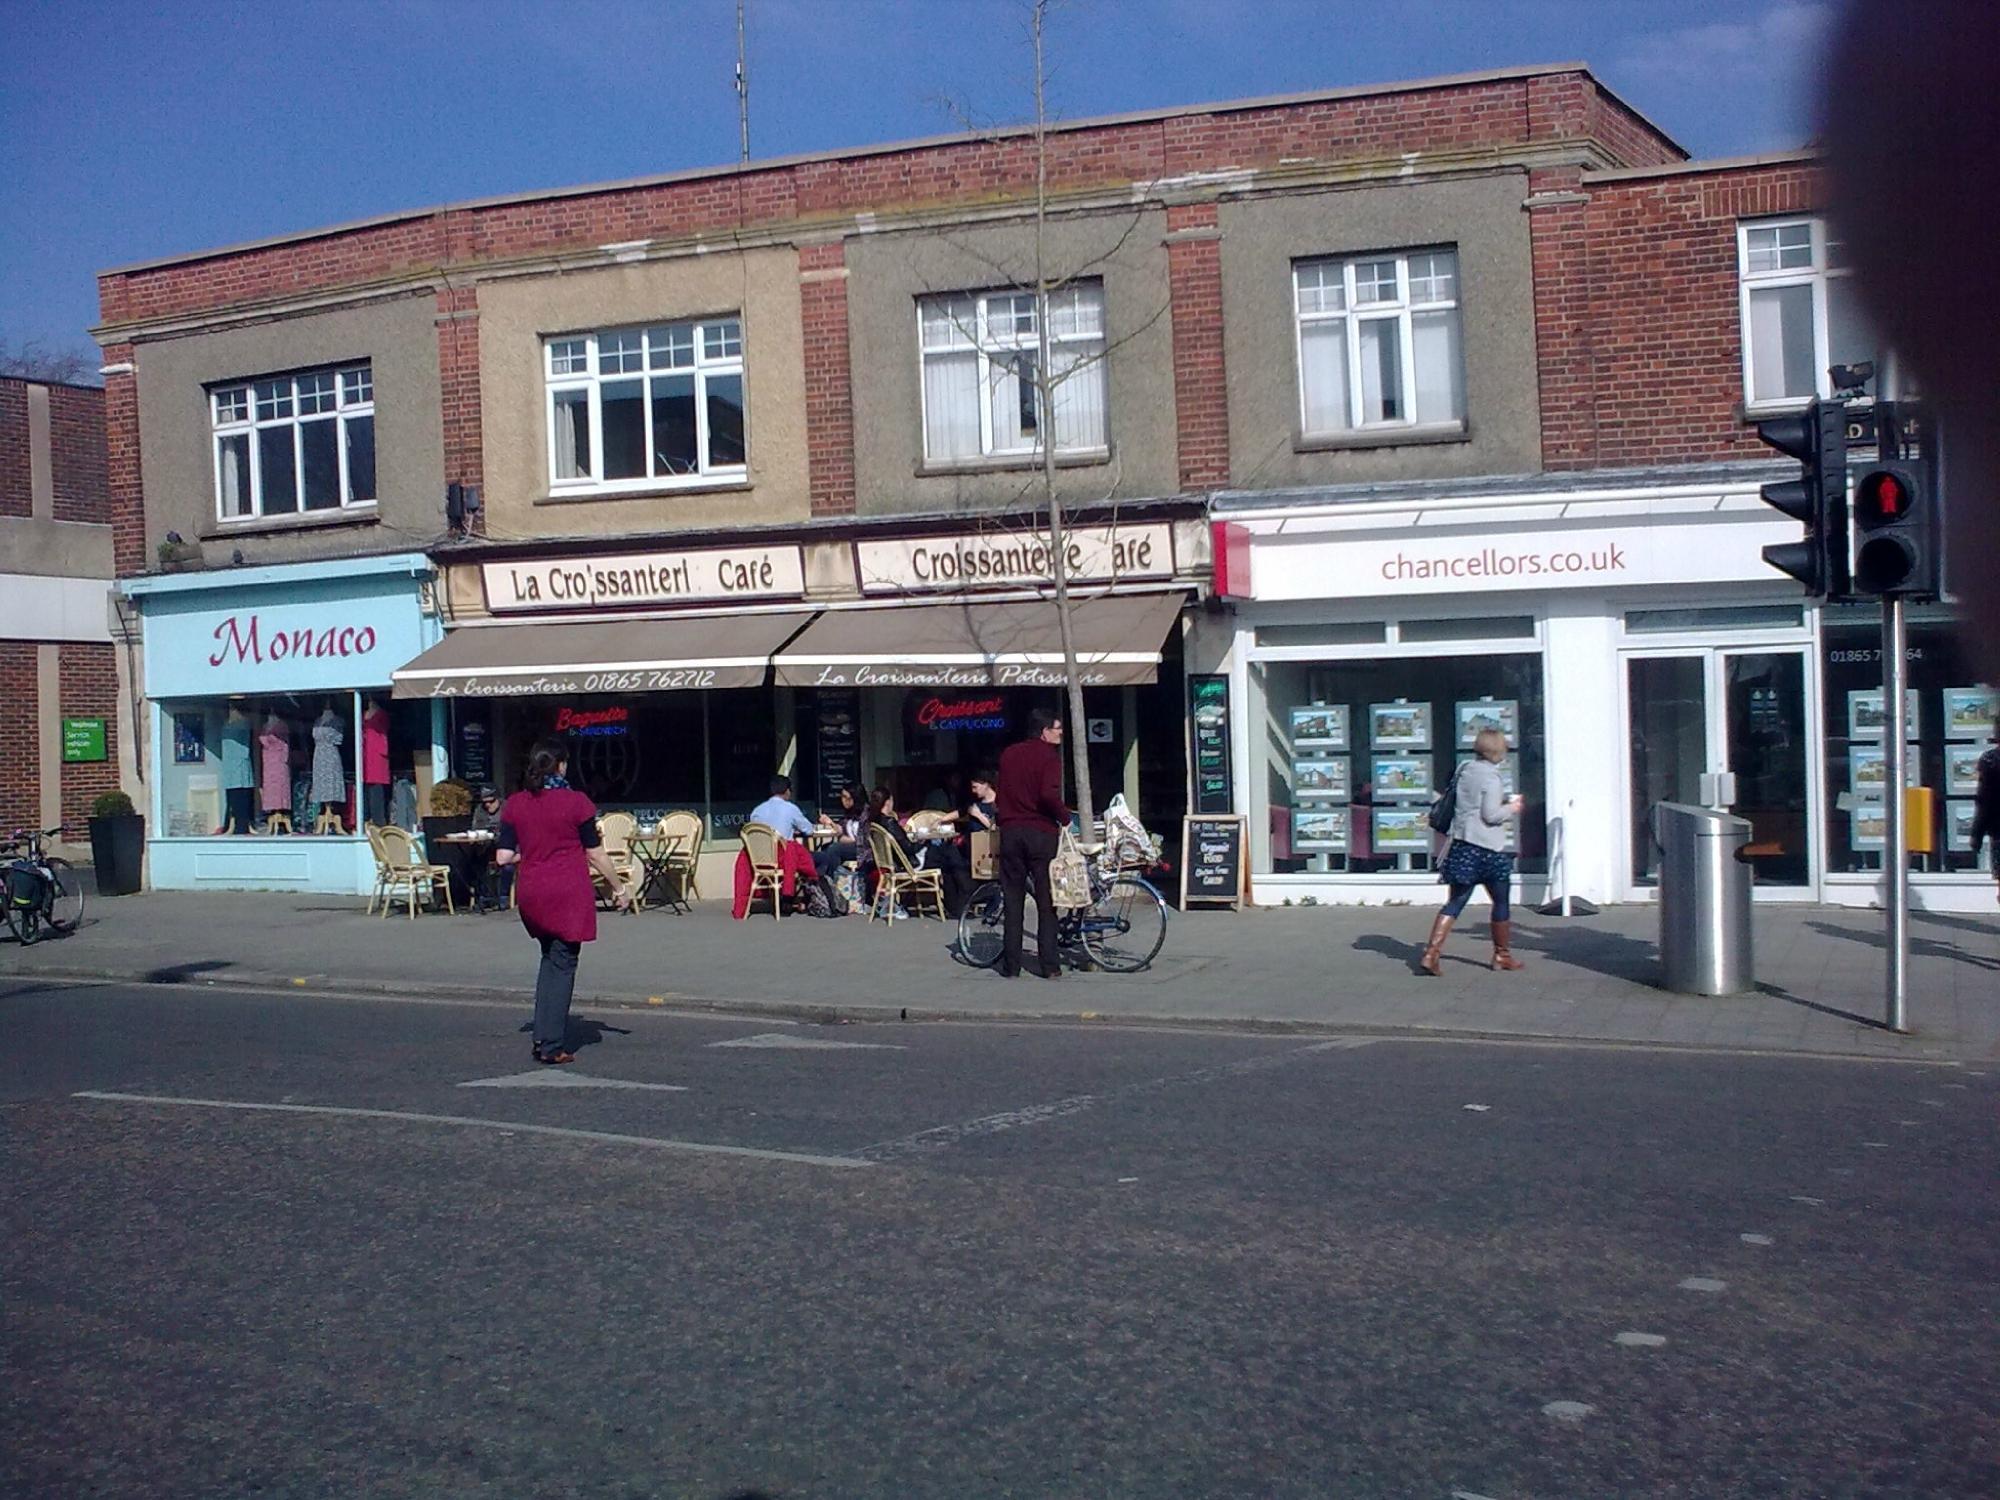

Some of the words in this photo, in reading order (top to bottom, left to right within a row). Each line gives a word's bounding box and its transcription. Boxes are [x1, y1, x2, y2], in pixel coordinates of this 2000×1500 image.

[511, 569, 541, 601] La
[717, 553, 775, 592] Café
[913, 542, 1083, 580] Croissantere
[1382, 543, 1626, 580] chancellors.co.uk
[209, 615, 376, 667] Monaco
[1830, 649, 1872, 662] 01865
[429, 678, 457, 697] La
[463, 678, 578, 695] Croissanterie
[584, 671, 644, 691] 01865
[648, 669, 716, 688] 762712
[814, 665, 847, 685] La
[855, 665, 991, 685] Croissanterie
